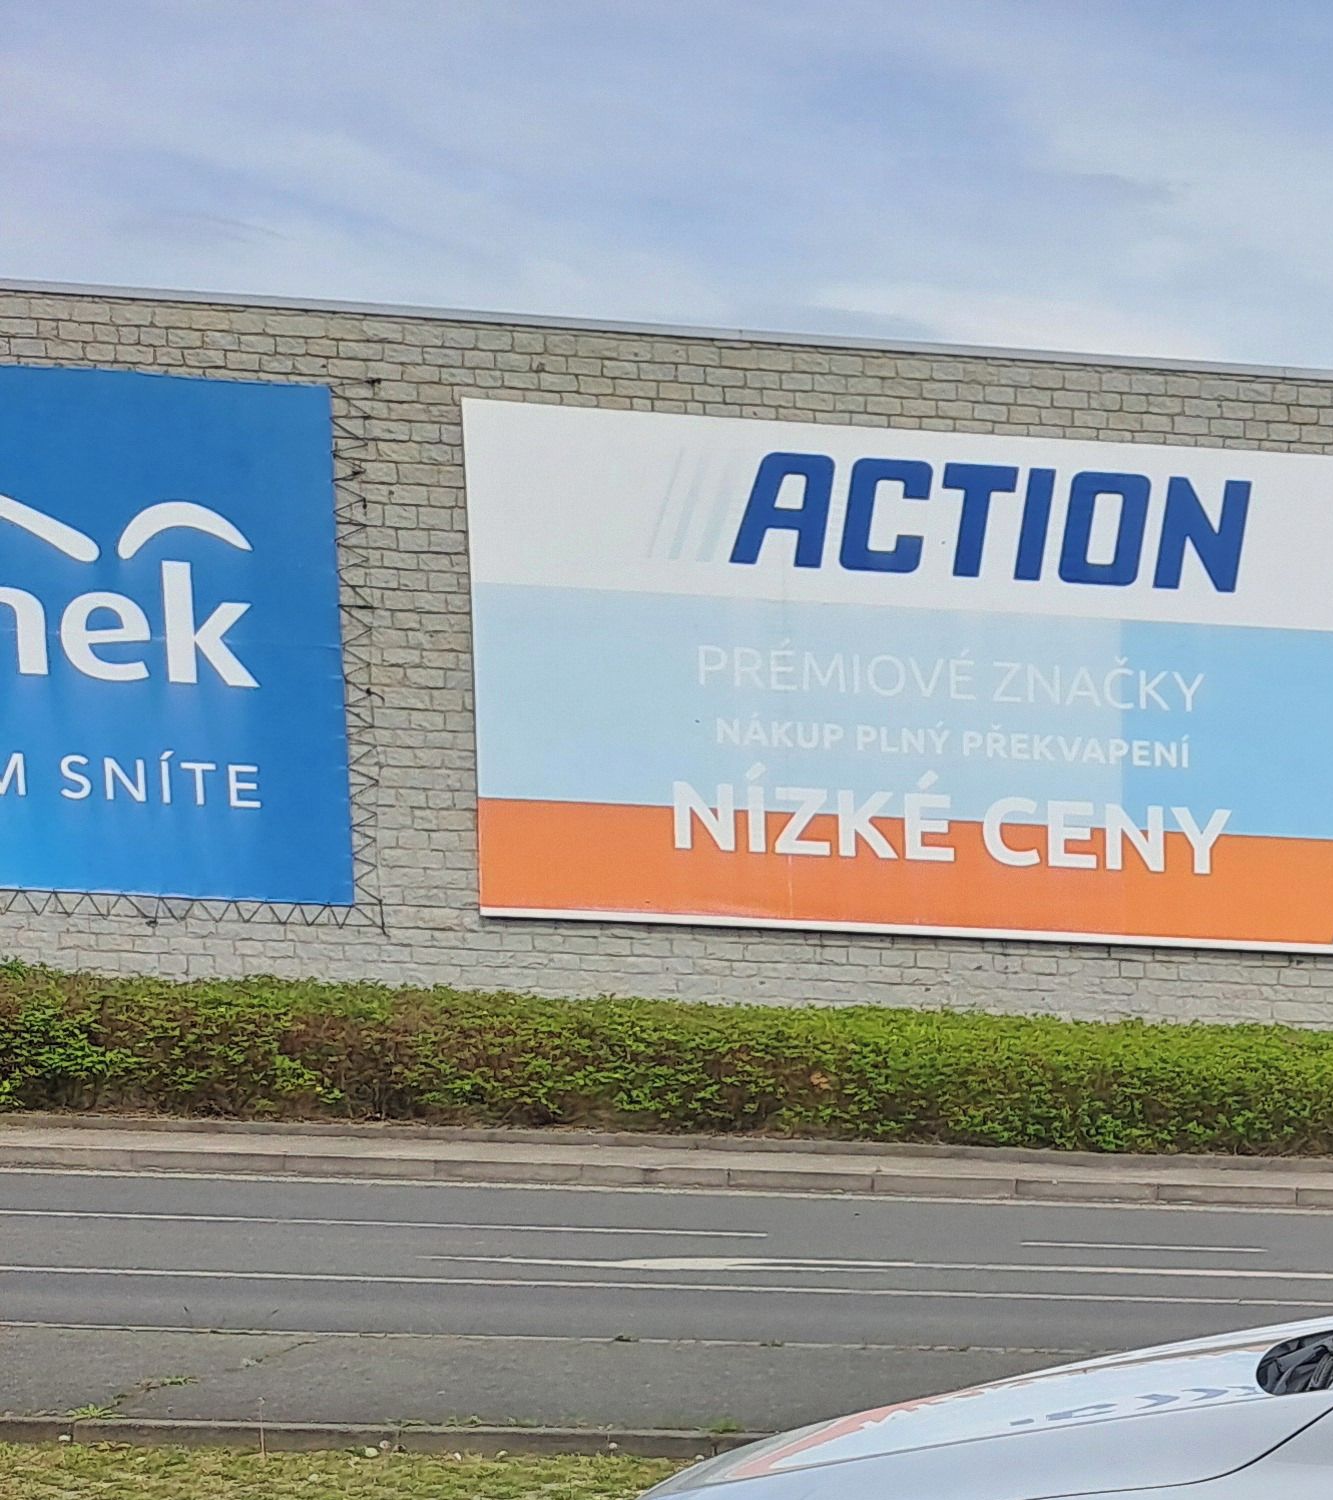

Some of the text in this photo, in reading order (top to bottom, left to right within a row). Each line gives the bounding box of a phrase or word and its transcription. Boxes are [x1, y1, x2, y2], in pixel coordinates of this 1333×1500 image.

[729, 451, 1252, 593] ACTION
[697, 637, 1205, 713] PRÉMIOVÉ ZNAČKY
[59, 749, 262, 809] SNÍTE
[714, 715, 1191, 769] NÁKUP PLNÝ PŘEKVAPENÍ
[672, 762, 1232, 875] NÍZKÉ CENY
